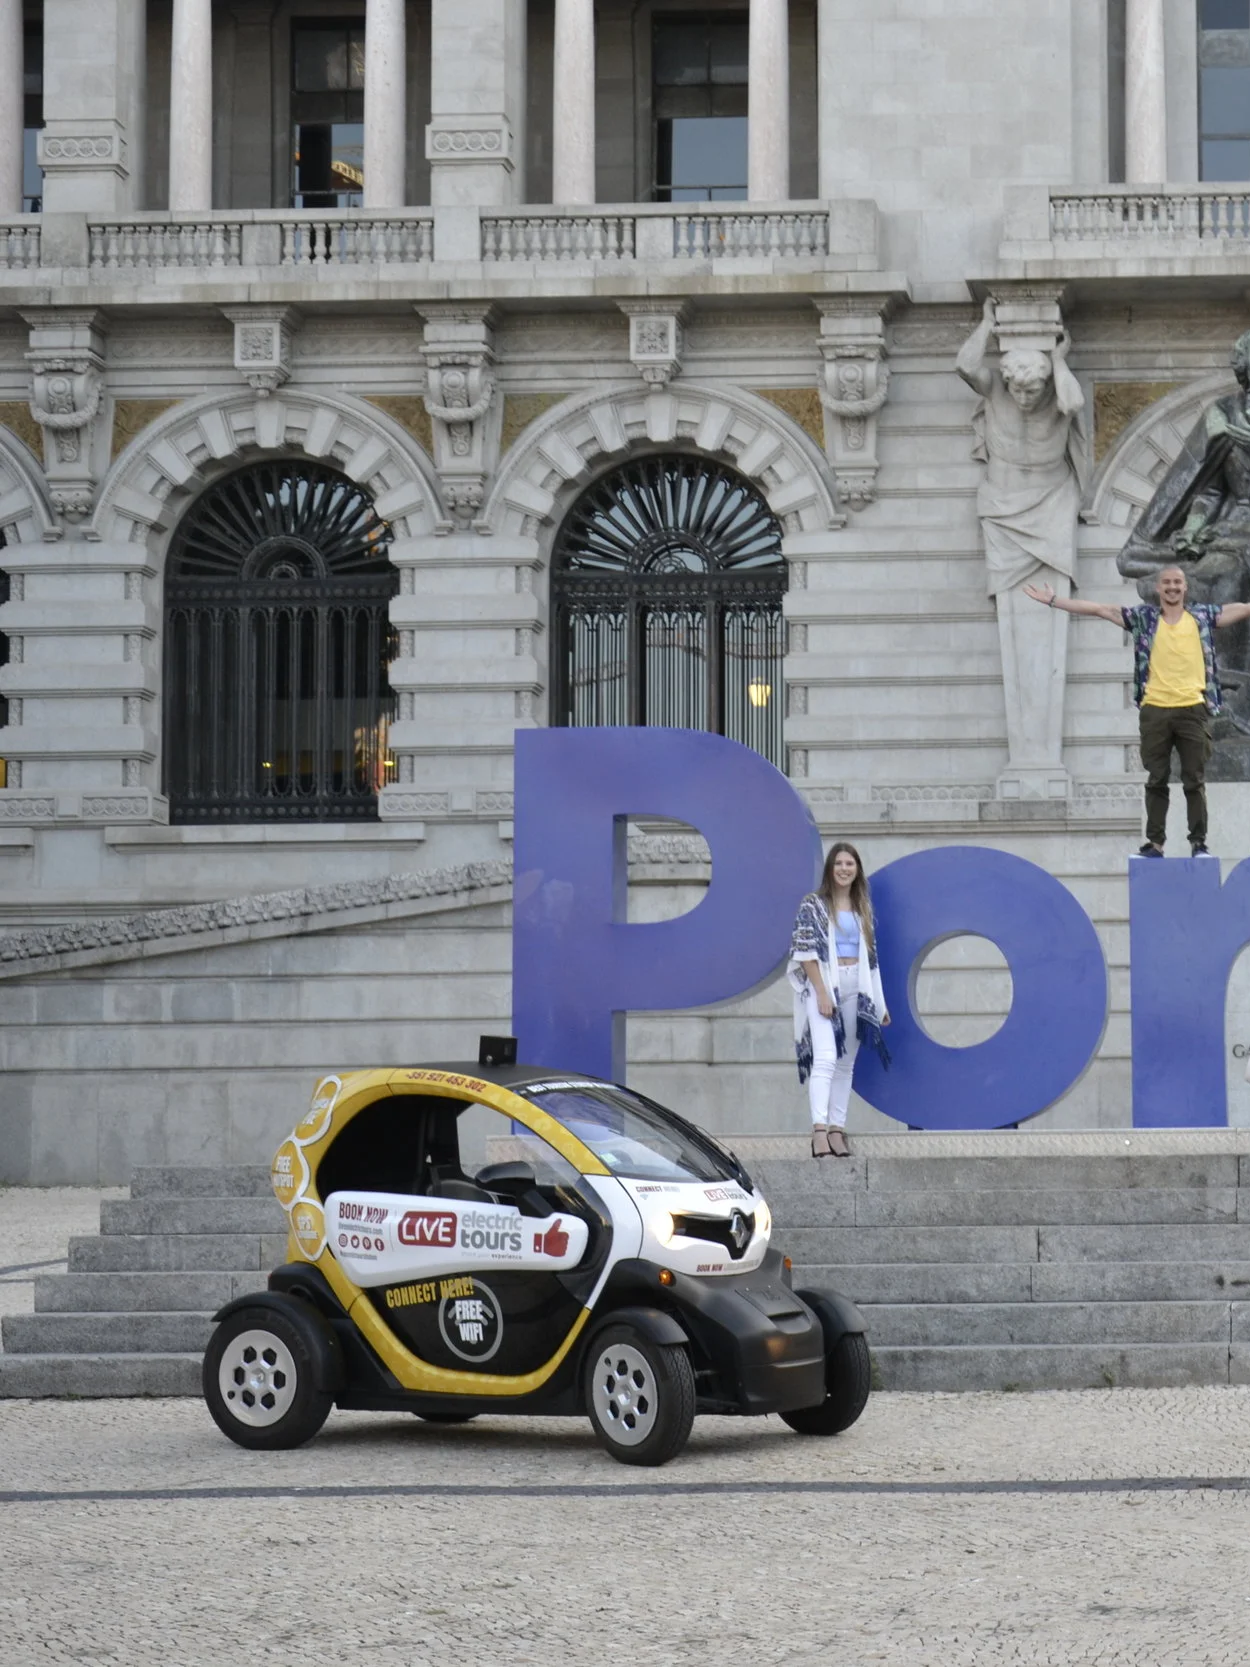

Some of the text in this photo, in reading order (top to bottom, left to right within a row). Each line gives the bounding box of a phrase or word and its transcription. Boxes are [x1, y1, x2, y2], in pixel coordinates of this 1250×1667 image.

[446, 1075, 466, 1087] 453
[465, 1080, 487, 1093] 302
[339, 1202, 389, 1224] BOOK NOW
[461, 1211, 523, 1230] electric
[402, 1217, 453, 1243] LIVE
[460, 1229, 522, 1251] tours
[386, 1276, 475, 1308] CONNECT HERE!
[455, 1300, 485, 1320] FREE
[459, 1323, 484, 1342] WIFI
